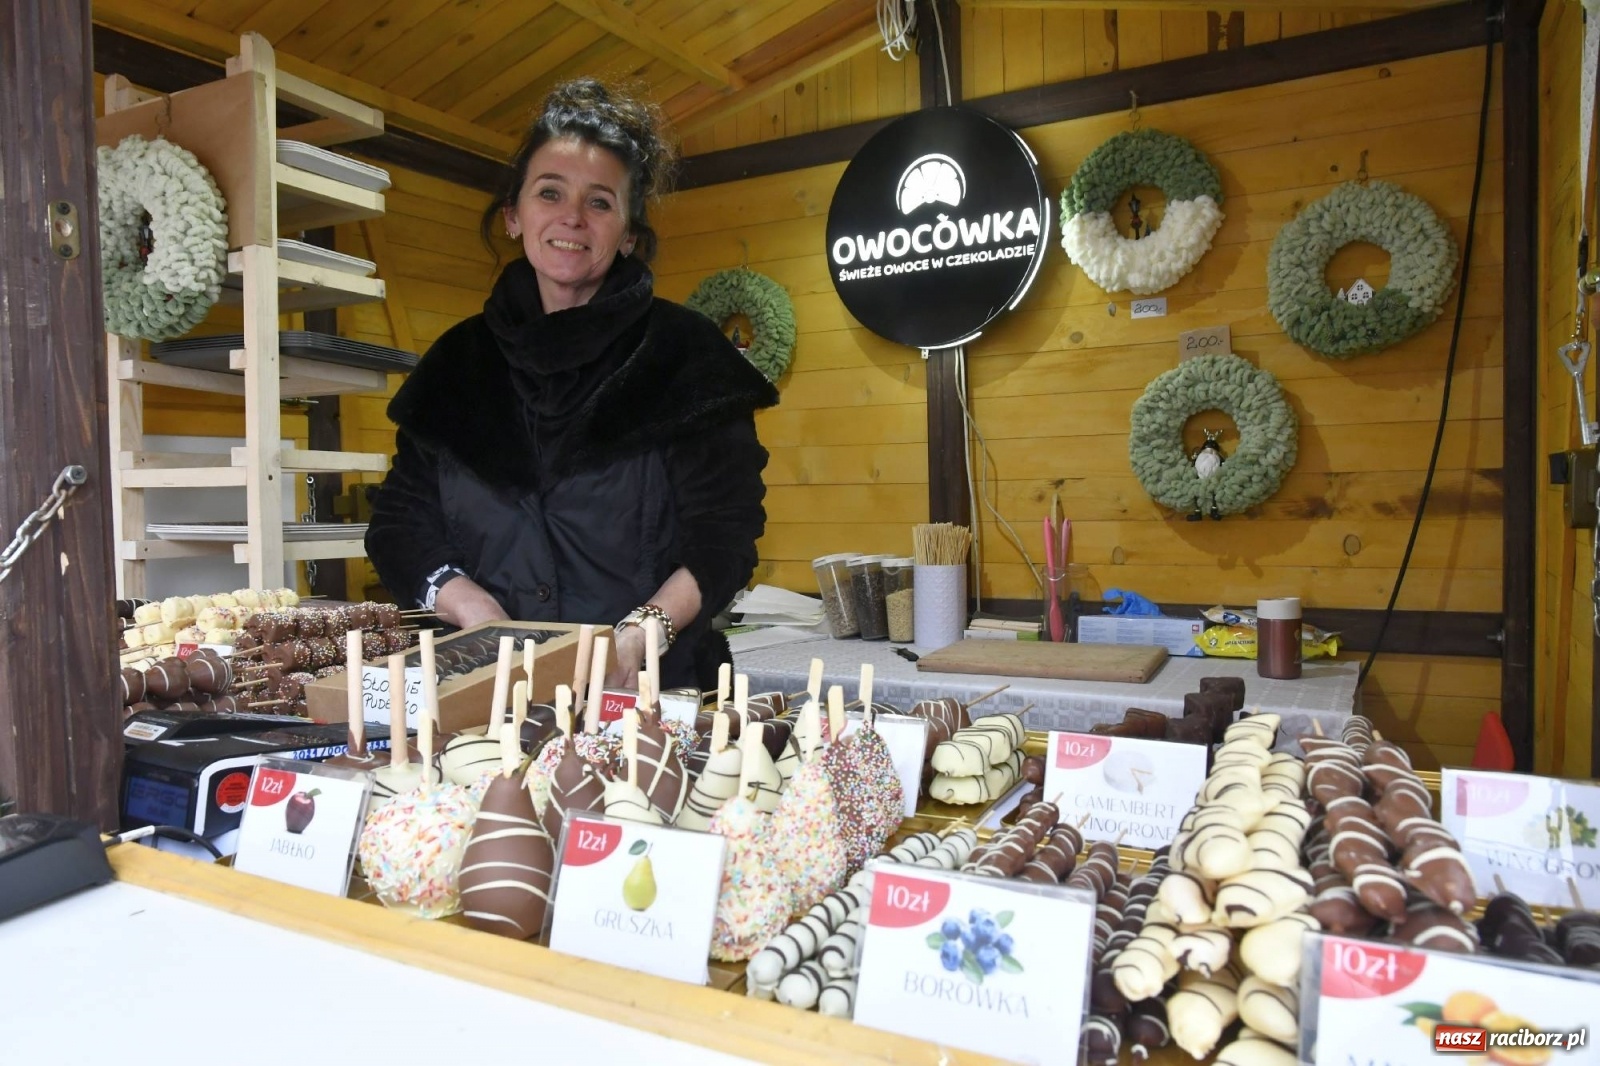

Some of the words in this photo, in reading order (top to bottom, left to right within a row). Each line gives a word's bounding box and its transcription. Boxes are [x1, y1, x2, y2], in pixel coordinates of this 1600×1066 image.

[839, 264, 882, 282] ŚWIEŻE
[883, 258, 930, 276] OWOCE
[931, 256, 944, 269] W
[945, 243, 1036, 267] CZEKOLADZIE
[605, 700, 624, 713] 12zł
[1064, 741, 1096, 757] 10zł
[261, 777, 284, 795] 12zł
[1074, 794, 1177, 820] CAMEMBERT
[270, 838, 315, 860] JABŁKO
[577, 829, 607, 851] 12zł
[886, 884, 930, 913] 10zł
[594, 909, 673, 940] GRUSZKA
[1333, 943, 1398, 982] 10zł
